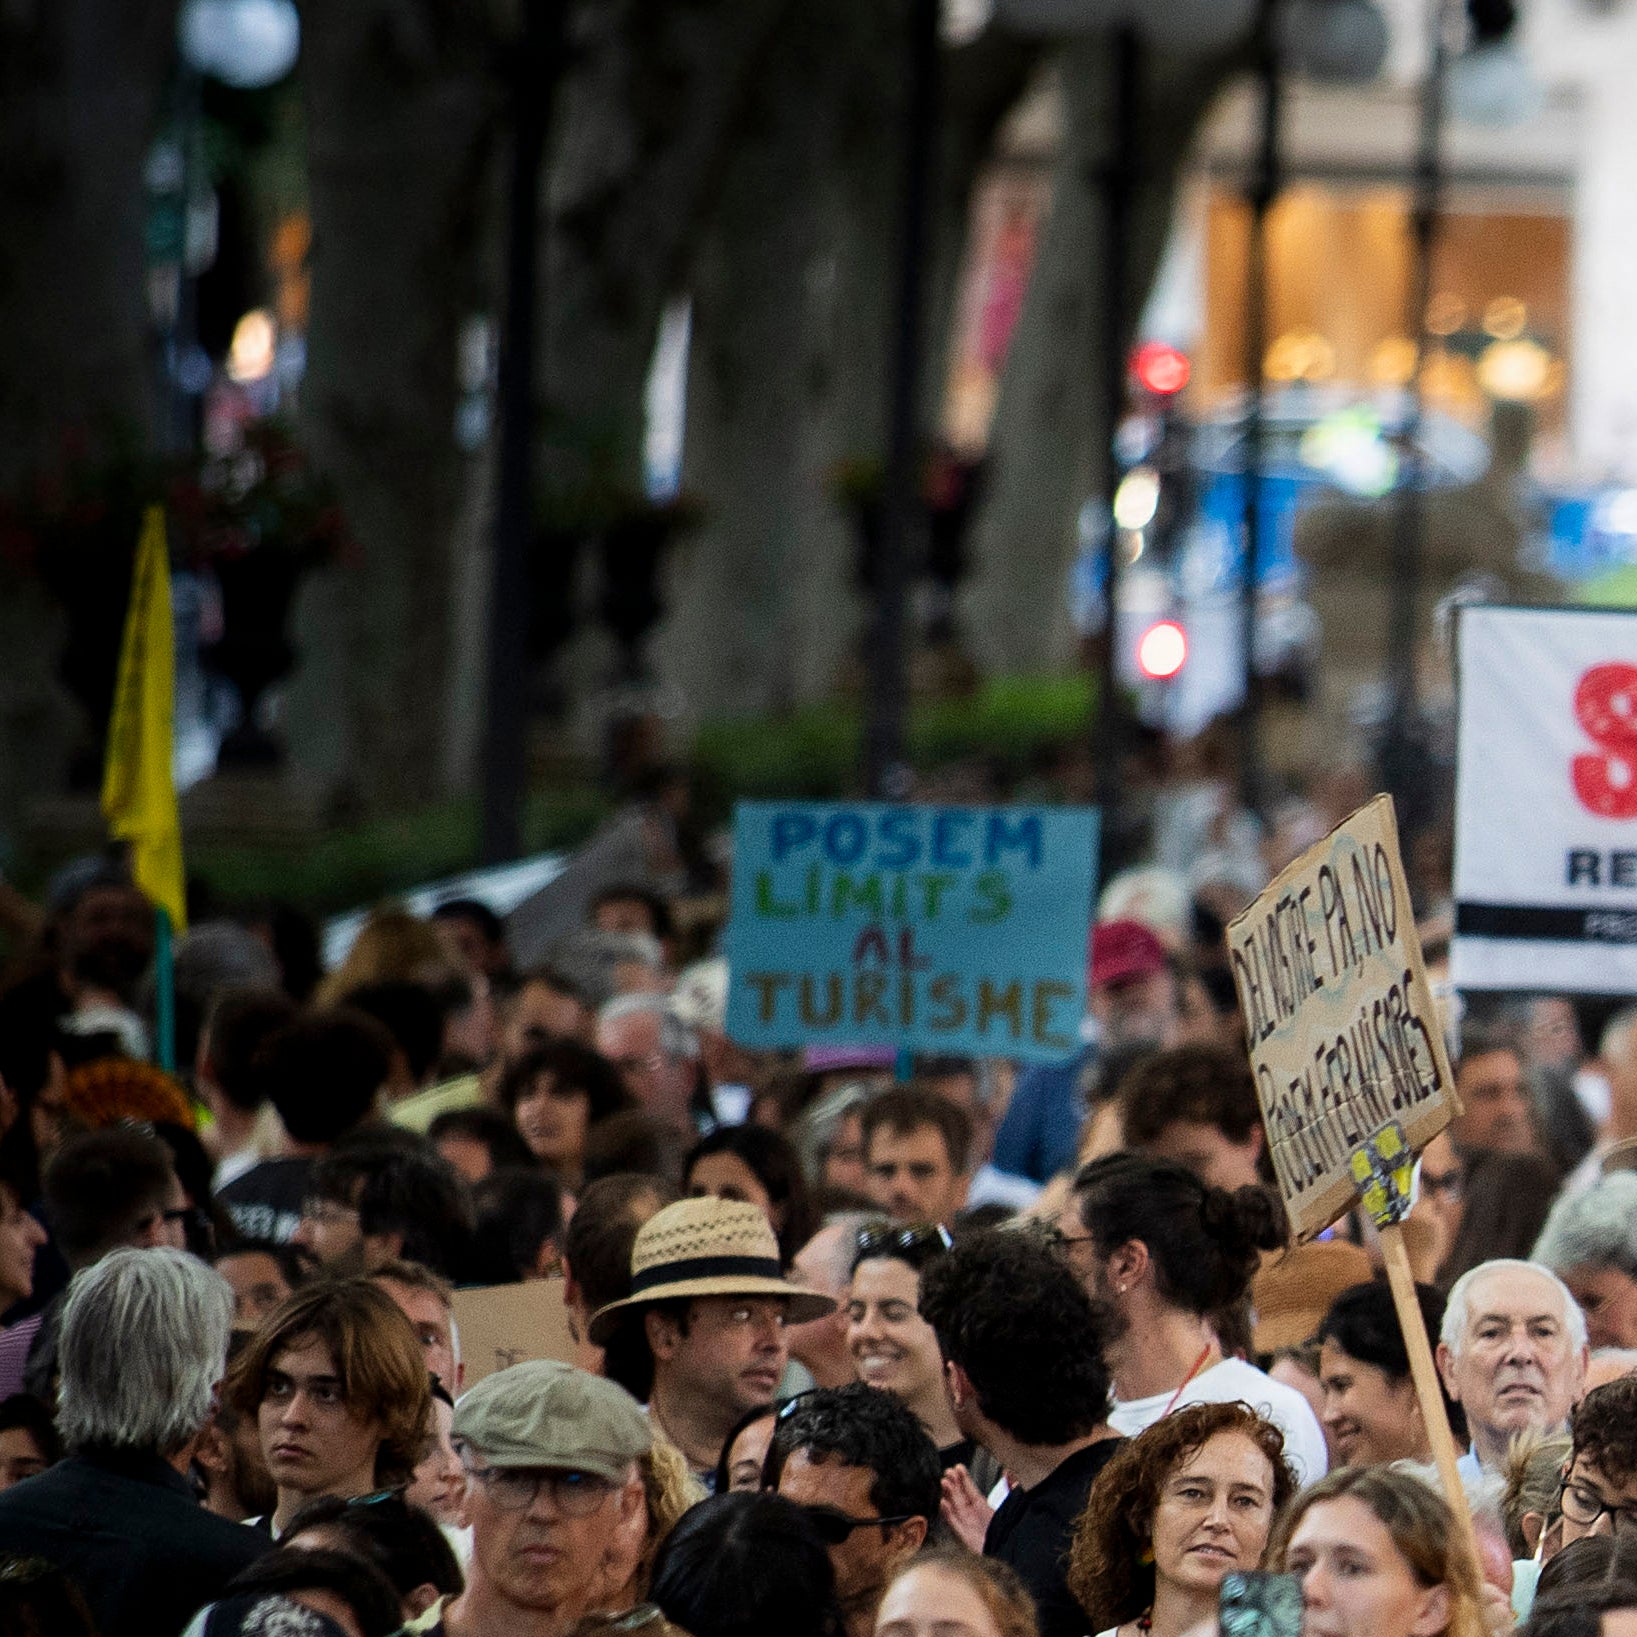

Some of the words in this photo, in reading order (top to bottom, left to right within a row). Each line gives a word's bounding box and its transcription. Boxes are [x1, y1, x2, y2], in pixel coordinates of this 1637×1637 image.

[769, 811, 1045, 871] POSEM
[754, 865, 1014, 924] LIMITS
[1352, 842, 1397, 956] NO
[853, 924, 932, 973] AL
[745, 970, 1074, 1049] TURISME
